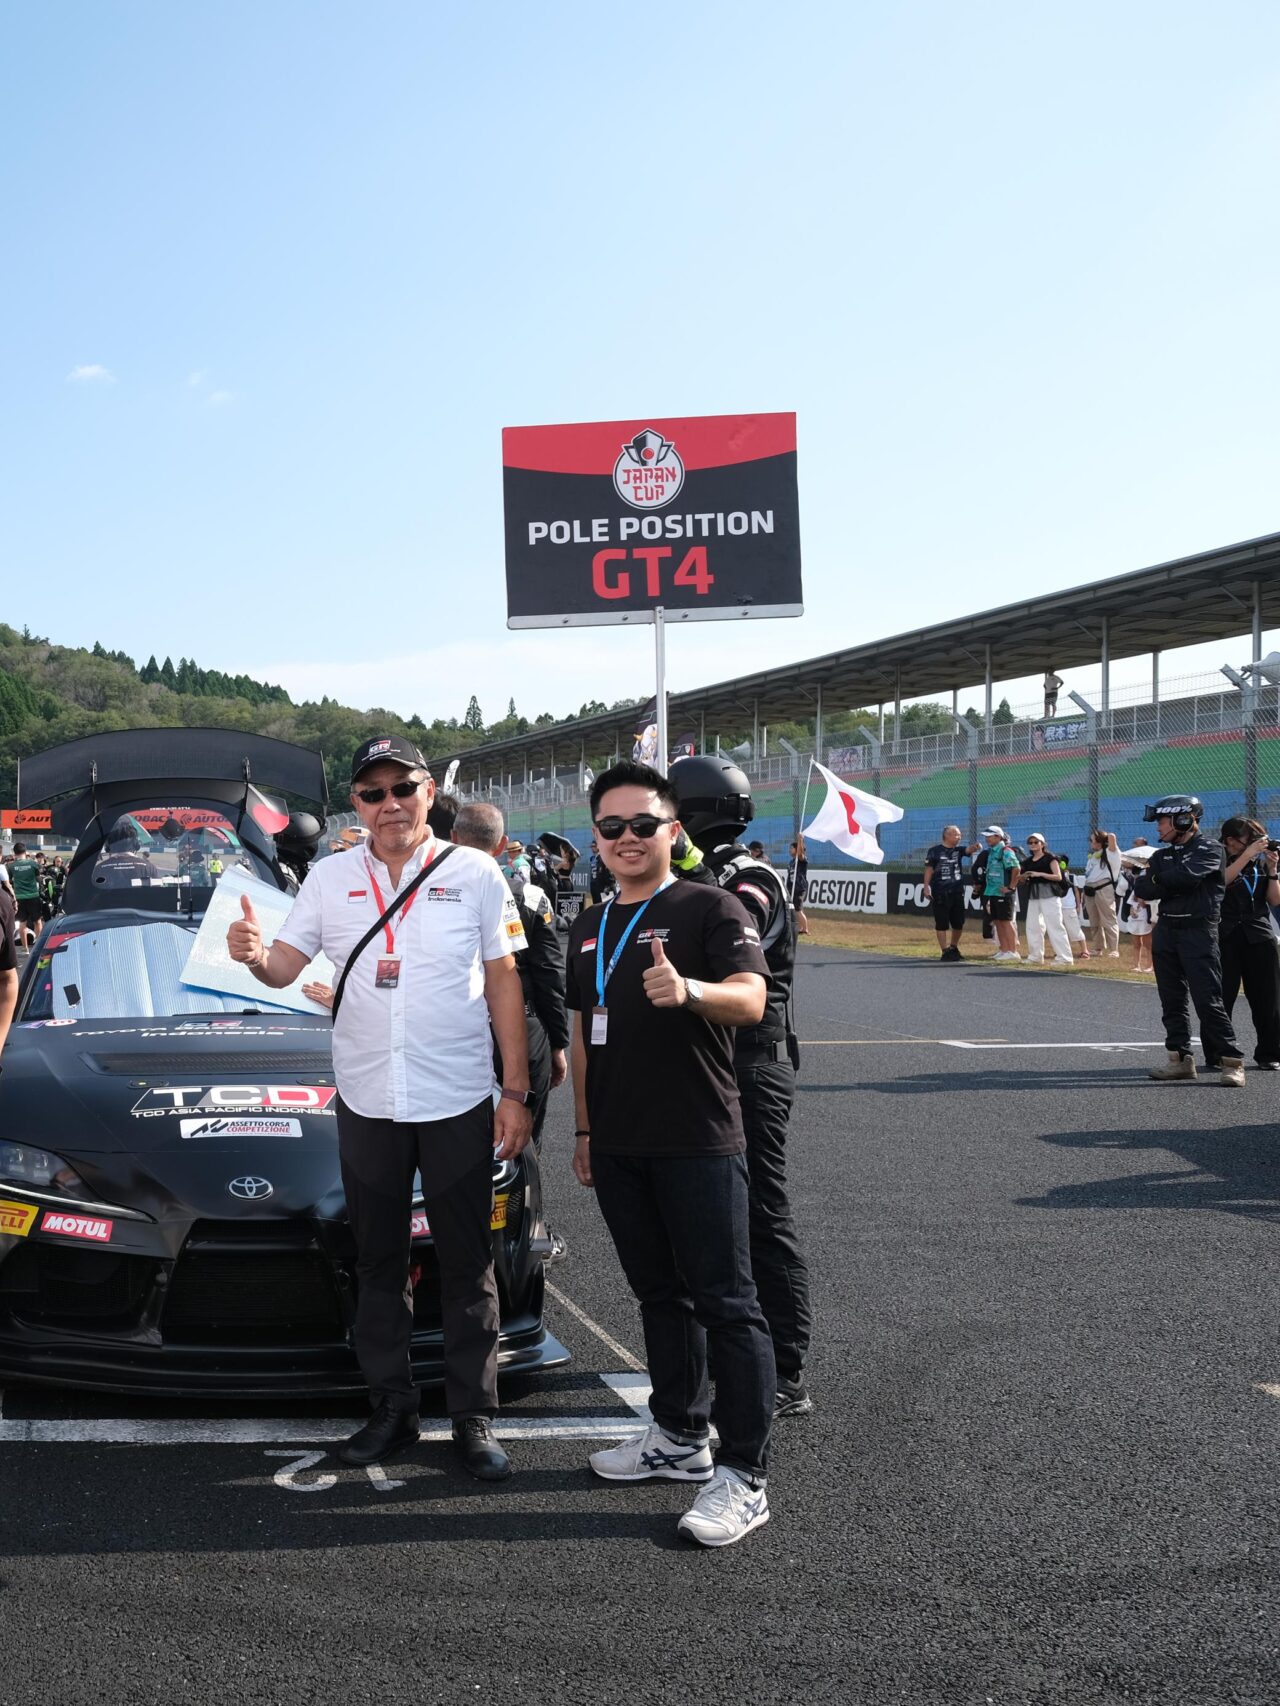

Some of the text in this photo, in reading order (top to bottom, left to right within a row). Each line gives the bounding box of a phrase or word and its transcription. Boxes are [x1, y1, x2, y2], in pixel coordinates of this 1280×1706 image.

[622, 466, 677, 485] JAPAN
[632, 485, 665, 501] CUP
[528, 510, 774, 545] POLE POSITION
[592, 546, 715, 599] GT4
[1156, 804, 1192, 814] 100%
[560, 902, 580, 914] 38
[153, 1087, 320, 1107] TCD
[131, 1106, 337, 1119] TCD ASIA PACIFIC INDONESI
[44, 1215, 108, 1238] MOTUL
